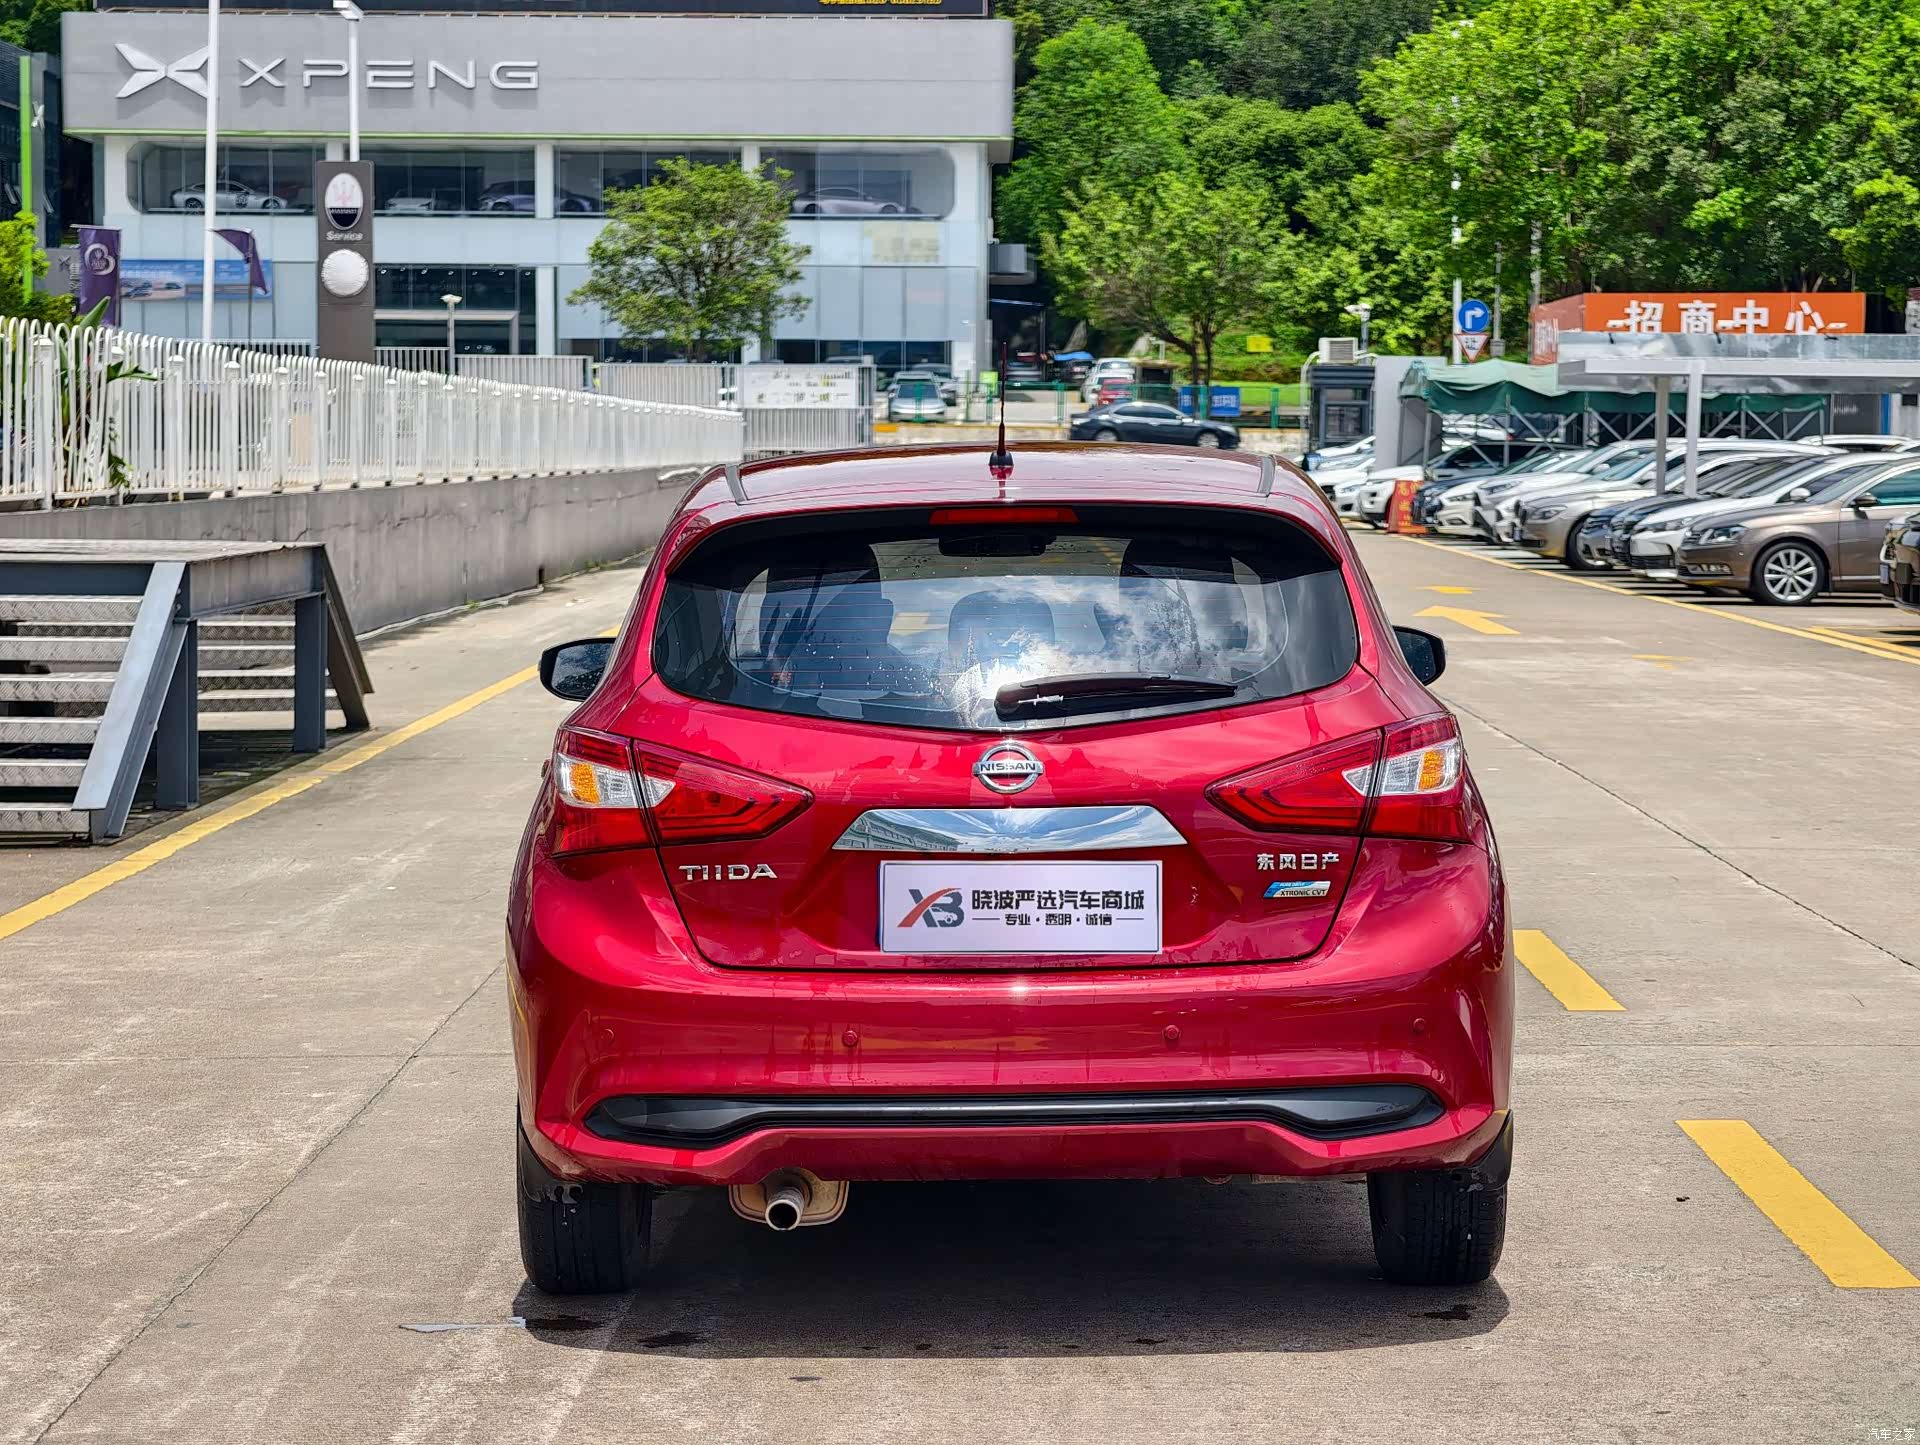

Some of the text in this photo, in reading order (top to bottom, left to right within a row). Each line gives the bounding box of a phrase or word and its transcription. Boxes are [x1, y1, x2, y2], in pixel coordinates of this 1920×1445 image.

[239, 57, 540, 90] XPENG
[325, 230, 364, 241] Service
[1622, 299, 1825, 335] 招商中心
[980, 762, 1036, 772] NISSAN
[1256, 852, 1340, 871] 东风日产
[678, 863, 778, 881] TIIDA
[971, 889, 1145, 910] 晓波严选汽车商城
[1280, 888, 1327, 897] XTRONIC CVT
